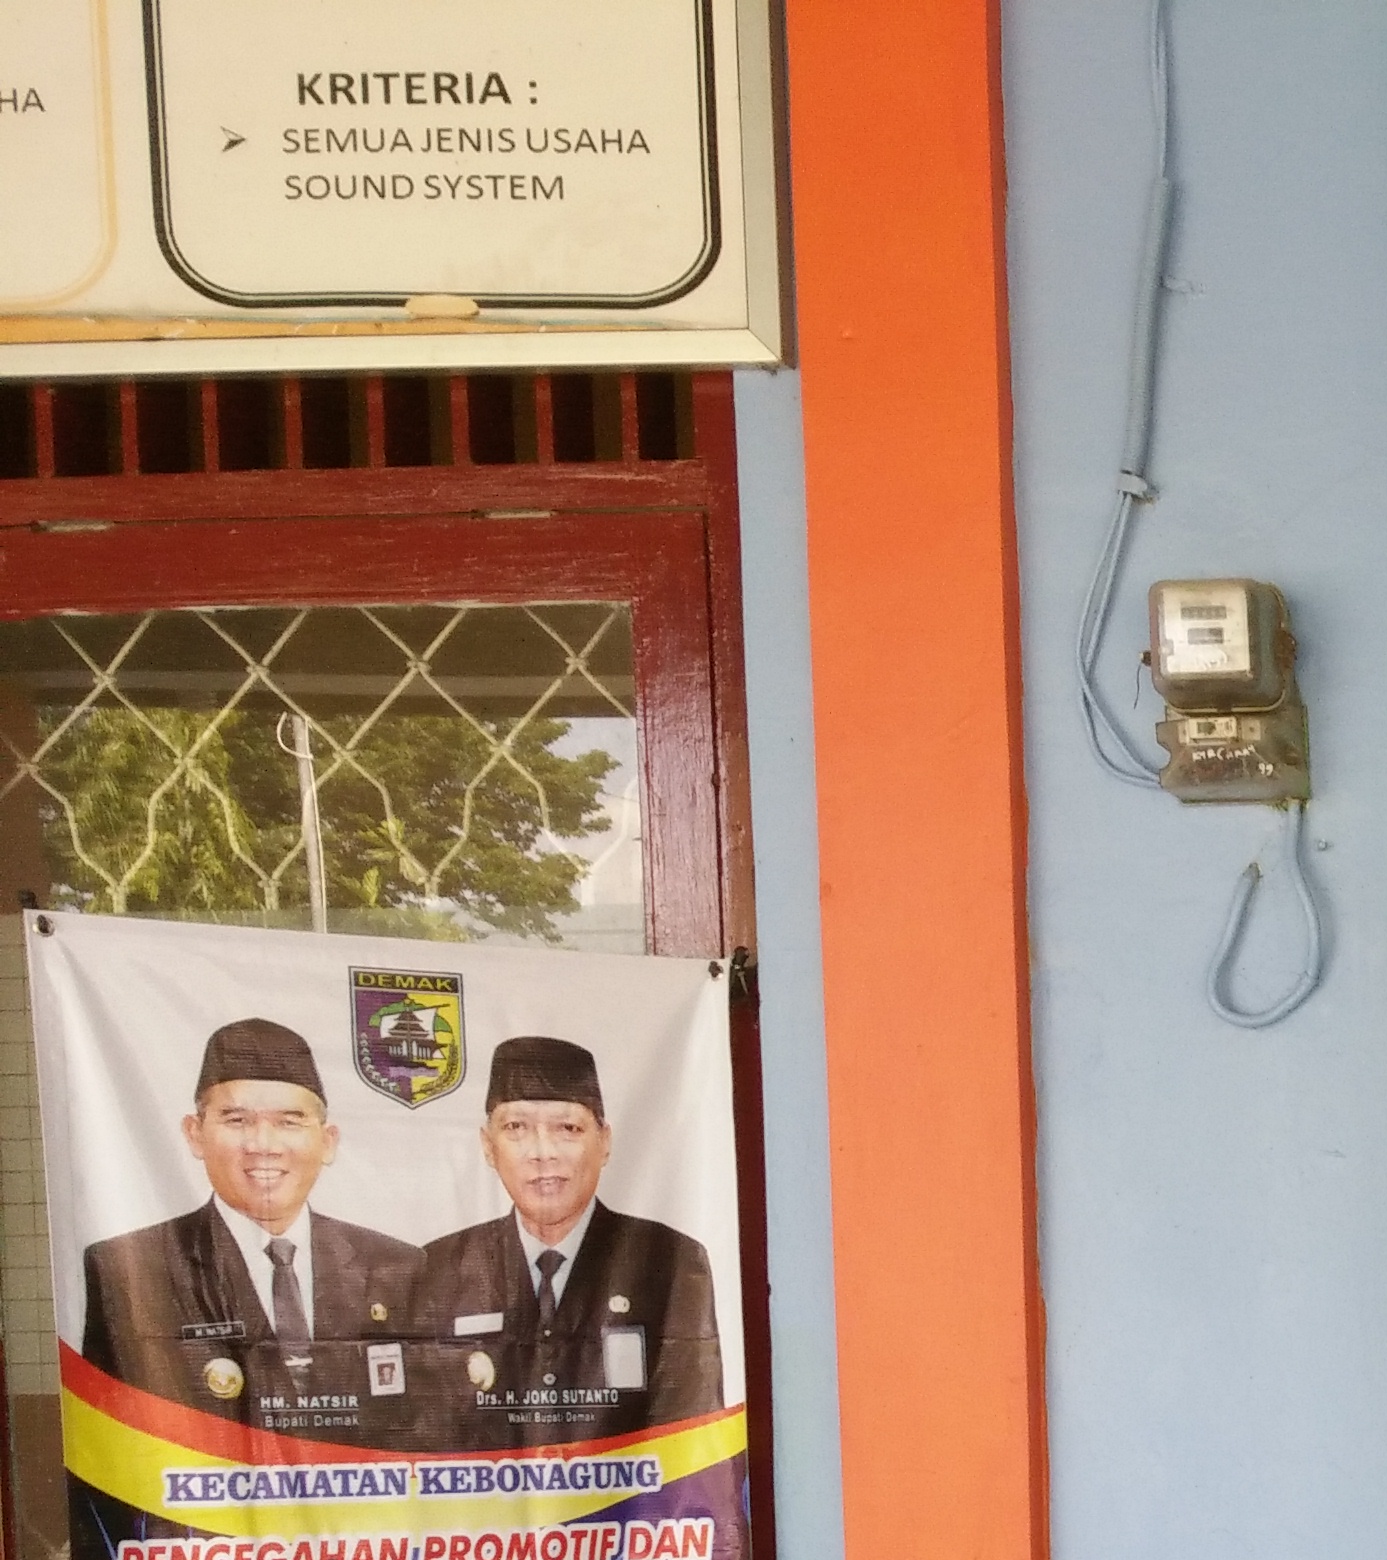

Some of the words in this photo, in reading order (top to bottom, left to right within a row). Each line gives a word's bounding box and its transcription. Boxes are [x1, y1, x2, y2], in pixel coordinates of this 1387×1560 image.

[297, 72, 511, 105] KRITERIA
[283, 128, 414, 154] SEMUA
[420, 127, 516, 153] JENIS
[525, 128, 651, 154] USAHA
[284, 175, 415, 200] SOUND
[424, 175, 565, 201] SYSTEM
[357, 971, 454, 993] DEMAK
[260, 1396, 290, 1409] HM.
[297, 1395, 359, 1408] NATSIR
[476, 1391, 500, 1406] Drs.
[506, 1391, 518, 1405] H.
[523, 1390, 558, 1405] JOKO
[562, 1389, 619, 1404] SUTANTO
[264, 1415, 308, 1428] Bupati
[313, 1415, 359, 1427] Demak
[508, 1411, 531, 1423] Wakil
[534, 1411, 565, 1423] Bupati
[566, 1411, 596, 1422] Demak
[168, 1465, 406, 1501] KECAMATAN
[419, 1459, 660, 1494] KEBONAGUNG
[627, 1521, 709, 1560] DAN
